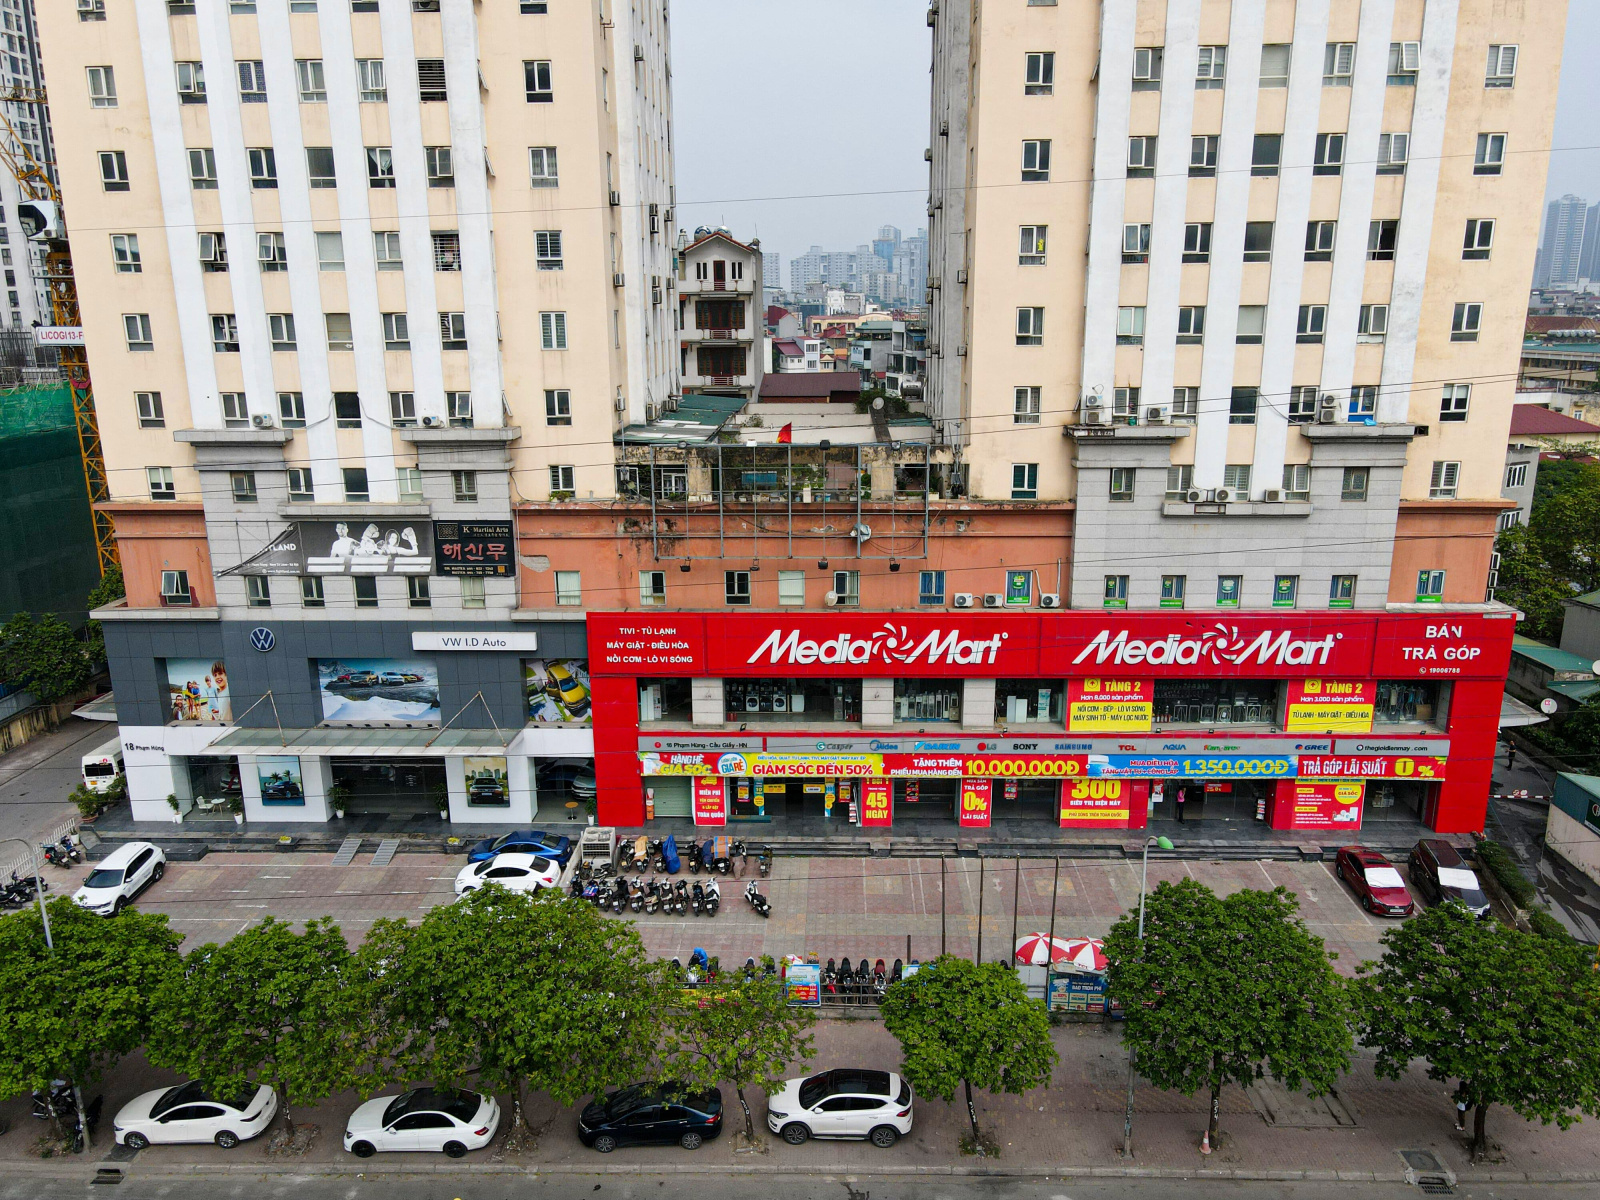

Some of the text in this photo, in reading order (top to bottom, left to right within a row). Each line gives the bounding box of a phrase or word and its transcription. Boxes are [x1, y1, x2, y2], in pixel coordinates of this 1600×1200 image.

[442, 543, 507, 561] 해신무
[619, 625, 677, 636] TIVI TỦ LẠNH
[1425, 622, 1463, 639] BÁN
[441, 637, 507, 647] VW I.D Auto
[606, 640, 625, 649] MÁY
[671, 640, 690, 649] HÒA
[746, 629, 1002, 665] Media Mart
[1071, 630, 1335, 666] Media Mart
[606, 654, 621, 663] NỒI
[647, 655, 658, 663] LÒ
[670, 654, 693, 663] SÓNG
[1402, 644, 1481, 660] TRẢ GÓP
[1134, 681, 1141, 692] 2
[1354, 683, 1363, 694] 2
[124, 742, 134, 751] 18
[752, 762, 873, 775] GIẢM SỐC ĐẾN 50%
[966, 759, 1080, 776] 10.000.000Đ
[1182, 759, 1289, 775] 1.350.000Đ
[1302, 756, 1321, 774] TRẢ
[1322, 758, 1342, 774] GÓP
[1071, 778, 1122, 799] 300
[866, 792, 888, 808] 45
[964, 791, 987, 811] 0%
[866, 808, 888, 819] NGÀY
